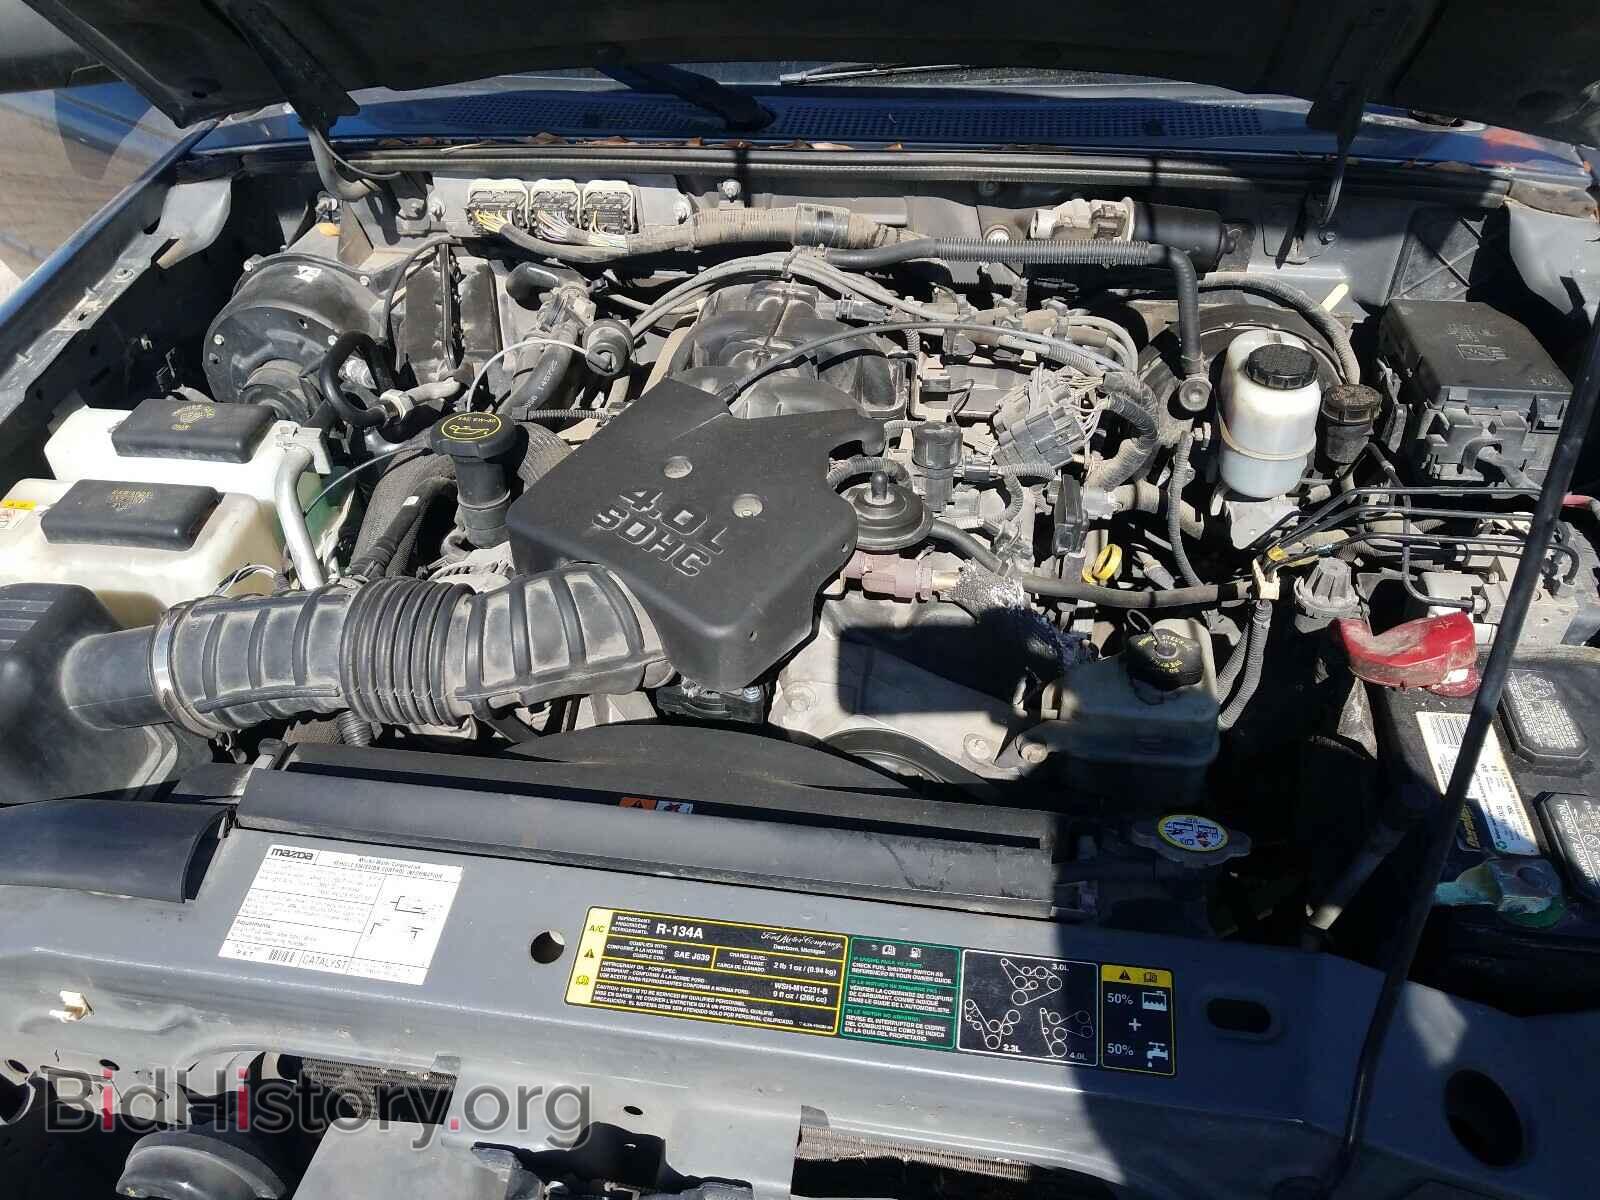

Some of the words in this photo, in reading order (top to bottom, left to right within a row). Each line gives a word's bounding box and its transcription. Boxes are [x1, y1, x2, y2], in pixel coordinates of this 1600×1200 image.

[592, 507, 712, 577] SOHC
[272, 848, 314, 860] mazda
[589, 924, 605, 933] A/C
[655, 923, 703, 939] R-134A
[674, 951, 690, 959] SAE
[302, 953, 349, 970] CATALYST
[1051, 963, 1069, 972] 3.0L
[1107, 992, 1134, 1005] 50%
[1003, 1044, 1022, 1053] 2.3L
[1107, 1042, 1134, 1056] 50%
[1069, 1052, 1087, 1060] 4.0L
